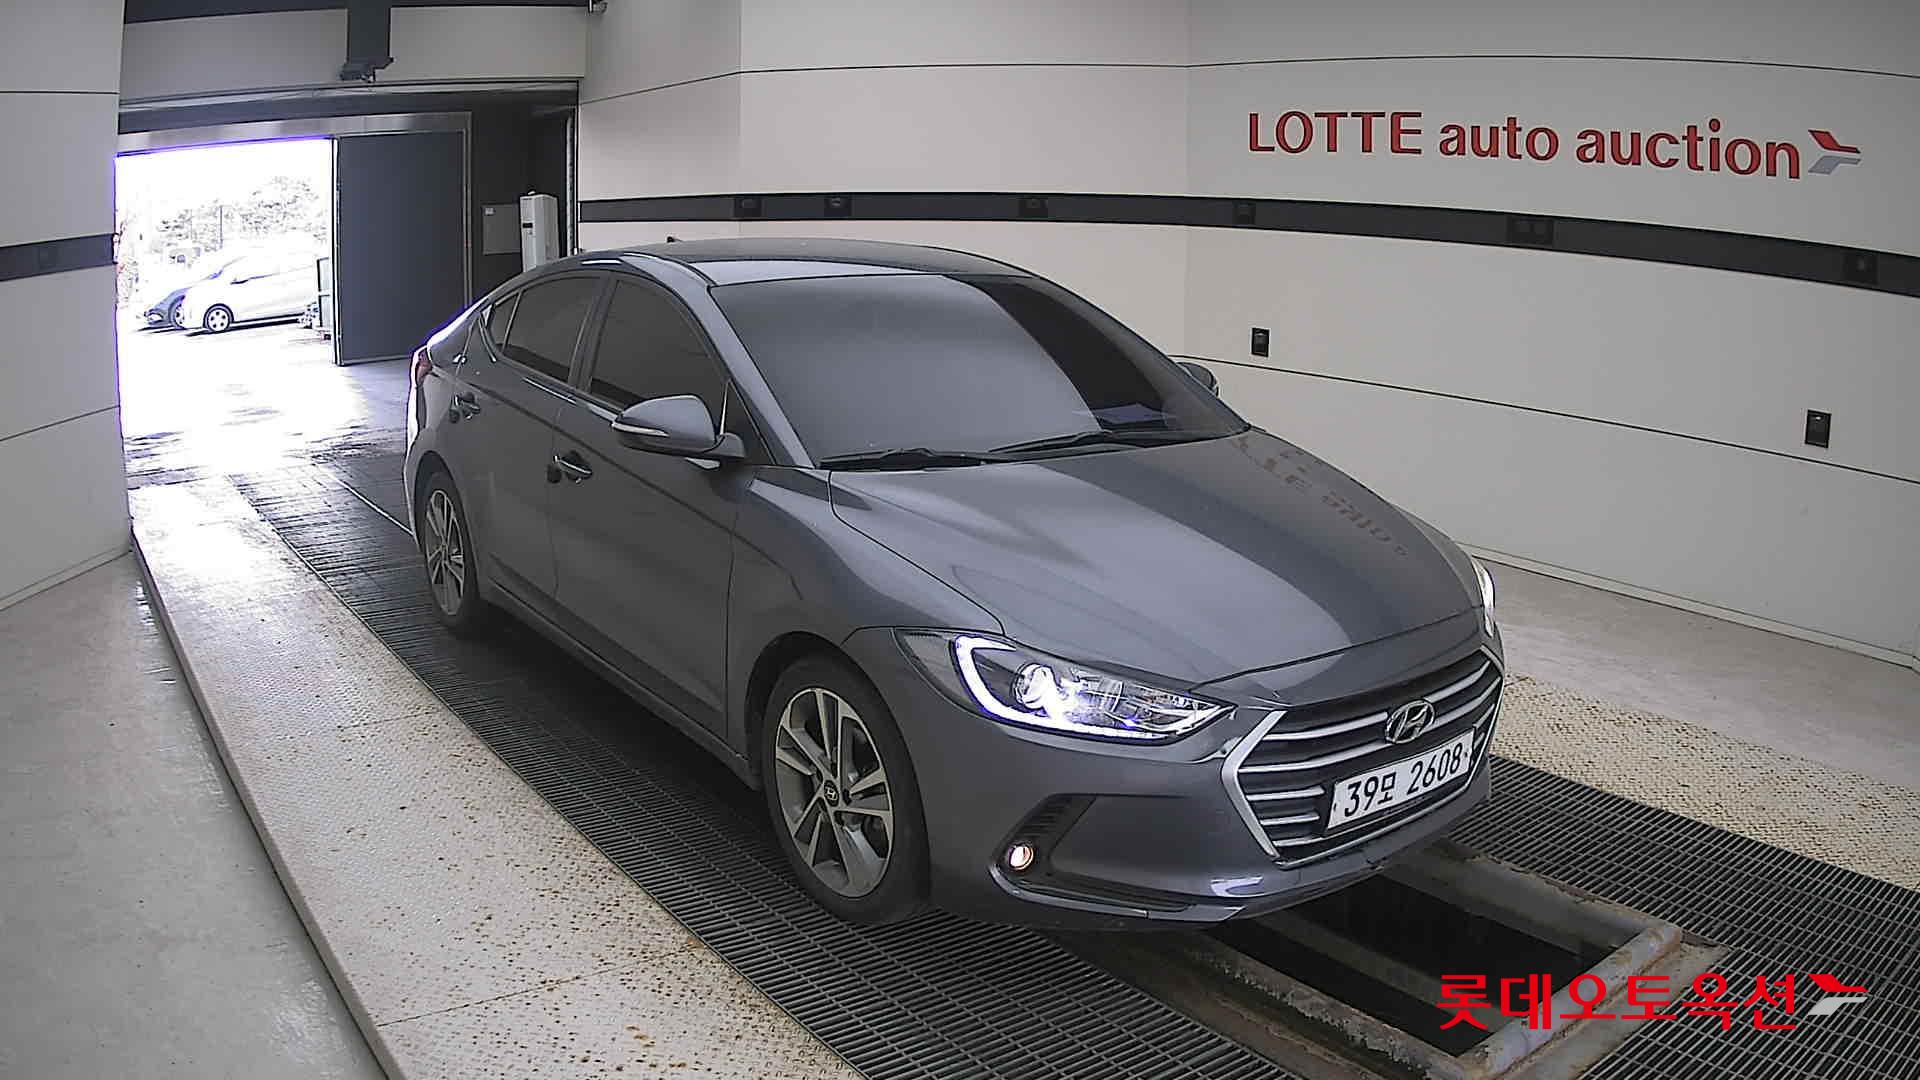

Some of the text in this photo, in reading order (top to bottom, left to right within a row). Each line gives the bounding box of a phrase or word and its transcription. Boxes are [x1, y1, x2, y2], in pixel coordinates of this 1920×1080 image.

[1248, 111, 1801, 178] LOTTE auto auction
[1344, 742, 1463, 817] 39모 2608
